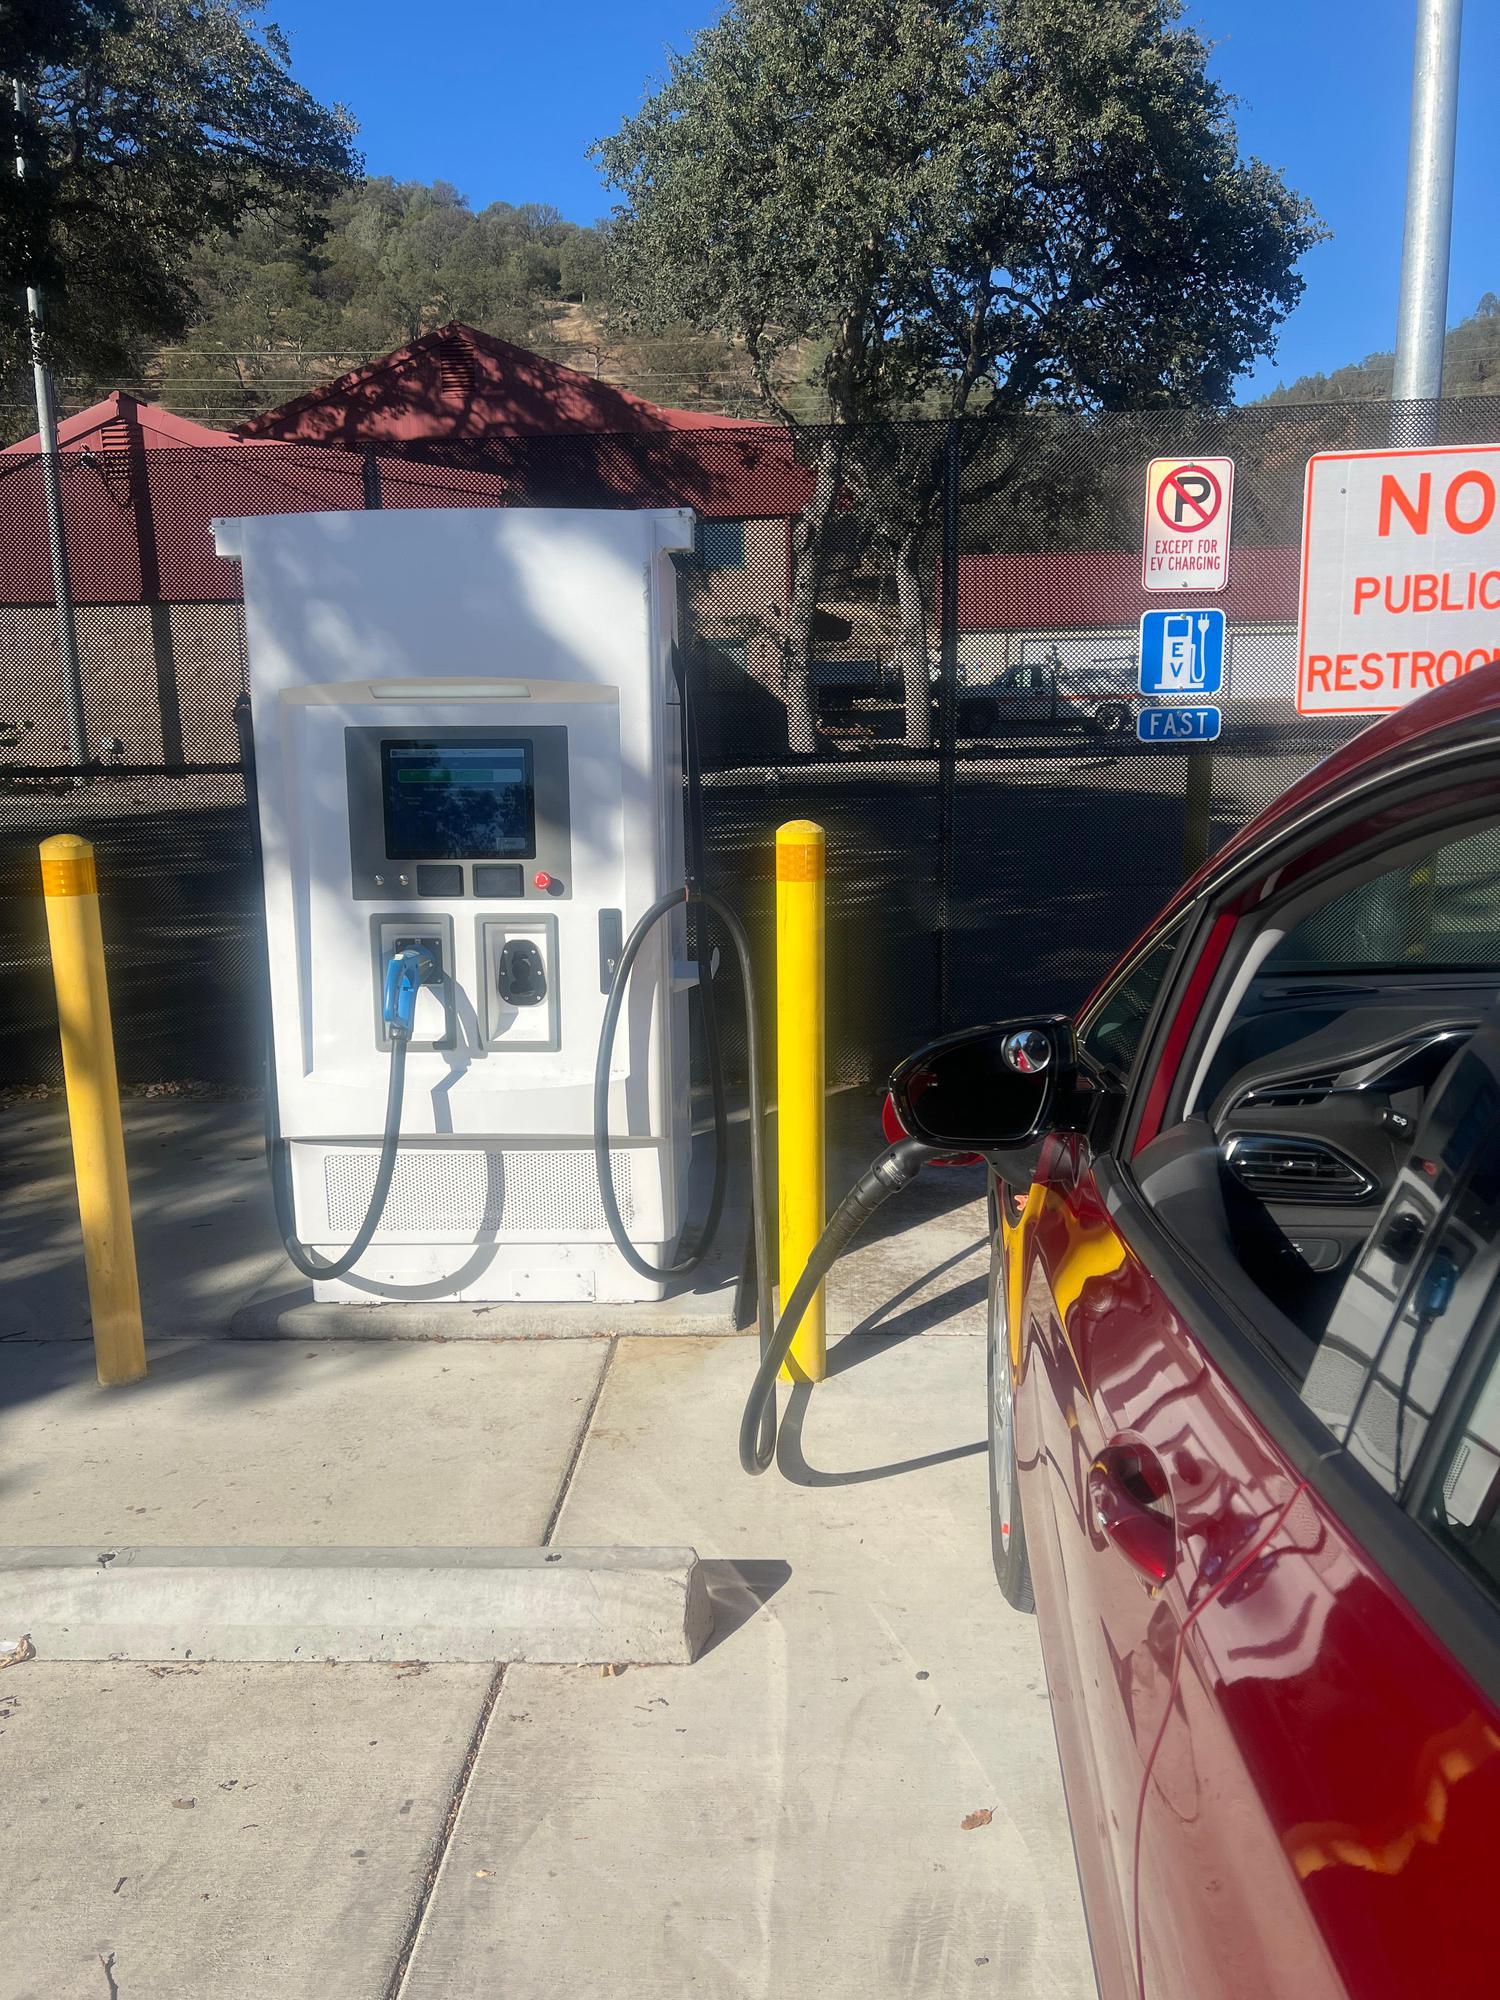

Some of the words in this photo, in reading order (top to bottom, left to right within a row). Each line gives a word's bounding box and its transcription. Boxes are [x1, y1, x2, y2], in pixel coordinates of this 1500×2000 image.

[1378, 470, 1496, 537] NO
[1150, 557, 1164, 571] EV
[1168, 556, 1221, 571] CHARGING
[1155, 540, 1192, 554] EXCEPT
[1198, 540, 1218, 554] FOR
[1353, 571, 1500, 615] PUBLIC
[1170, 642, 1183, 677] EV
[1307, 648, 1500, 693] RESTROO
[1150, 712, 1208, 736] FAST
